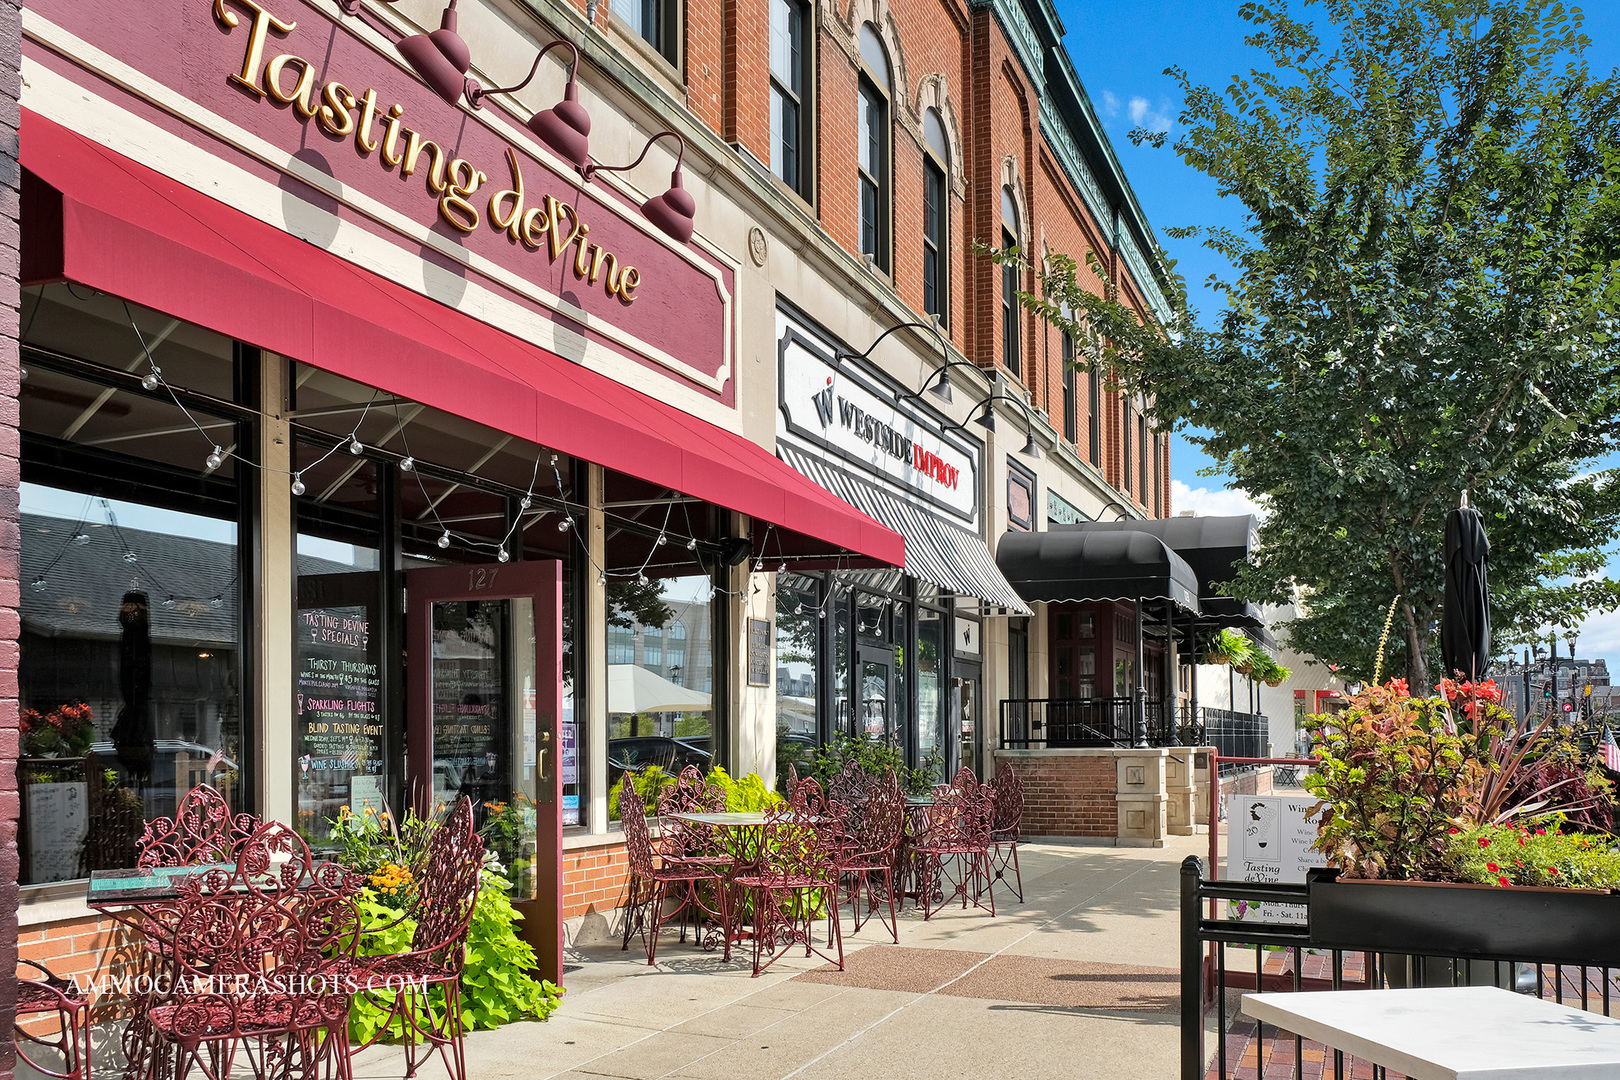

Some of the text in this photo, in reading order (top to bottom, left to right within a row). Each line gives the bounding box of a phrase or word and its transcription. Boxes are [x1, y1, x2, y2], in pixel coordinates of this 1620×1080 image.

[212, 0, 488, 232] Tasting
[837, 395, 913, 466] WESTSIDE
[913, 443, 960, 491] IMPROV
[468, 568, 499, 591] 127
[303, 613, 369, 635] TASTING DEVINE
[322, 629, 360, 646] SPECIALS
[308, 658, 377, 675] THIRSTY THURSDAYS
[345, 674, 353, 684] $5
[307, 698, 375, 713] SPARKLING FLIGHTS
[308, 722, 383, 735] BLIND TASTING EVENT
[311, 759, 327, 769] WINE
[329, 759, 359, 770] SLUSHIES
[1288, 804, 1307, 813] Win
[1304, 817, 1318, 825] Ro
[1297, 828, 1314, 836] Wine
[1291, 837, 1307, 845] Wine
[1297, 856, 1315, 864] Share
[1243, 860, 1281, 875] Tasting
[1244, 872, 1279, 883] deVine
[1262, 909, 1275, 917] Fri.
[1281, 910, 1294, 919] Sat.
